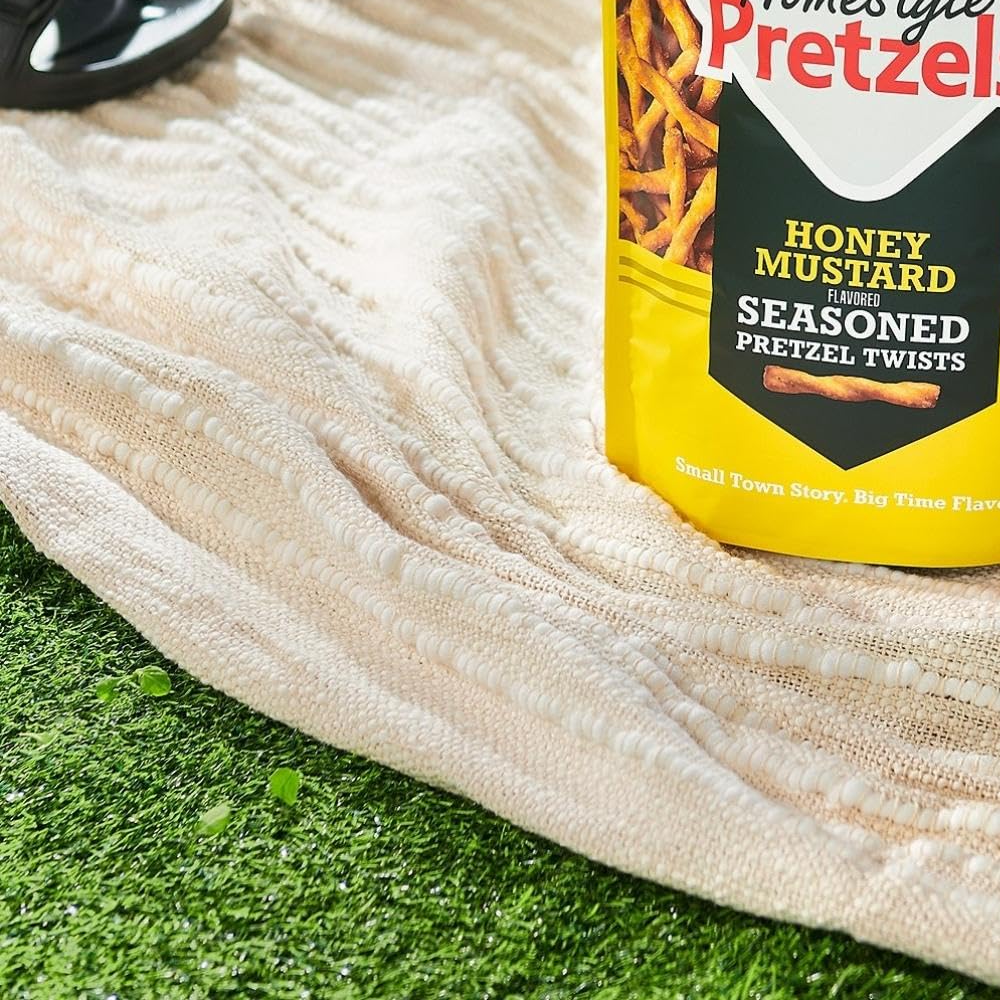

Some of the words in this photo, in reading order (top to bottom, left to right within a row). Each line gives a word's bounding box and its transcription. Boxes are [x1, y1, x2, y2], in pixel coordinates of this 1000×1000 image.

[785, 219, 931, 260] HONEY
[754, 247, 956, 293] MUSTARD
[737, 295, 970, 344] SEASONED
[827, 288, 881, 308] FLAVORED
[735, 330, 855, 366] PRETZEL
[862, 348, 966, 372] TWISTS
[675, 456, 725, 486] Small
[730, 472, 785, 497] Town
[790, 482, 848, 505] Story.
[854, 489, 889, 510] Big
[893, 492, 947, 511] Time
